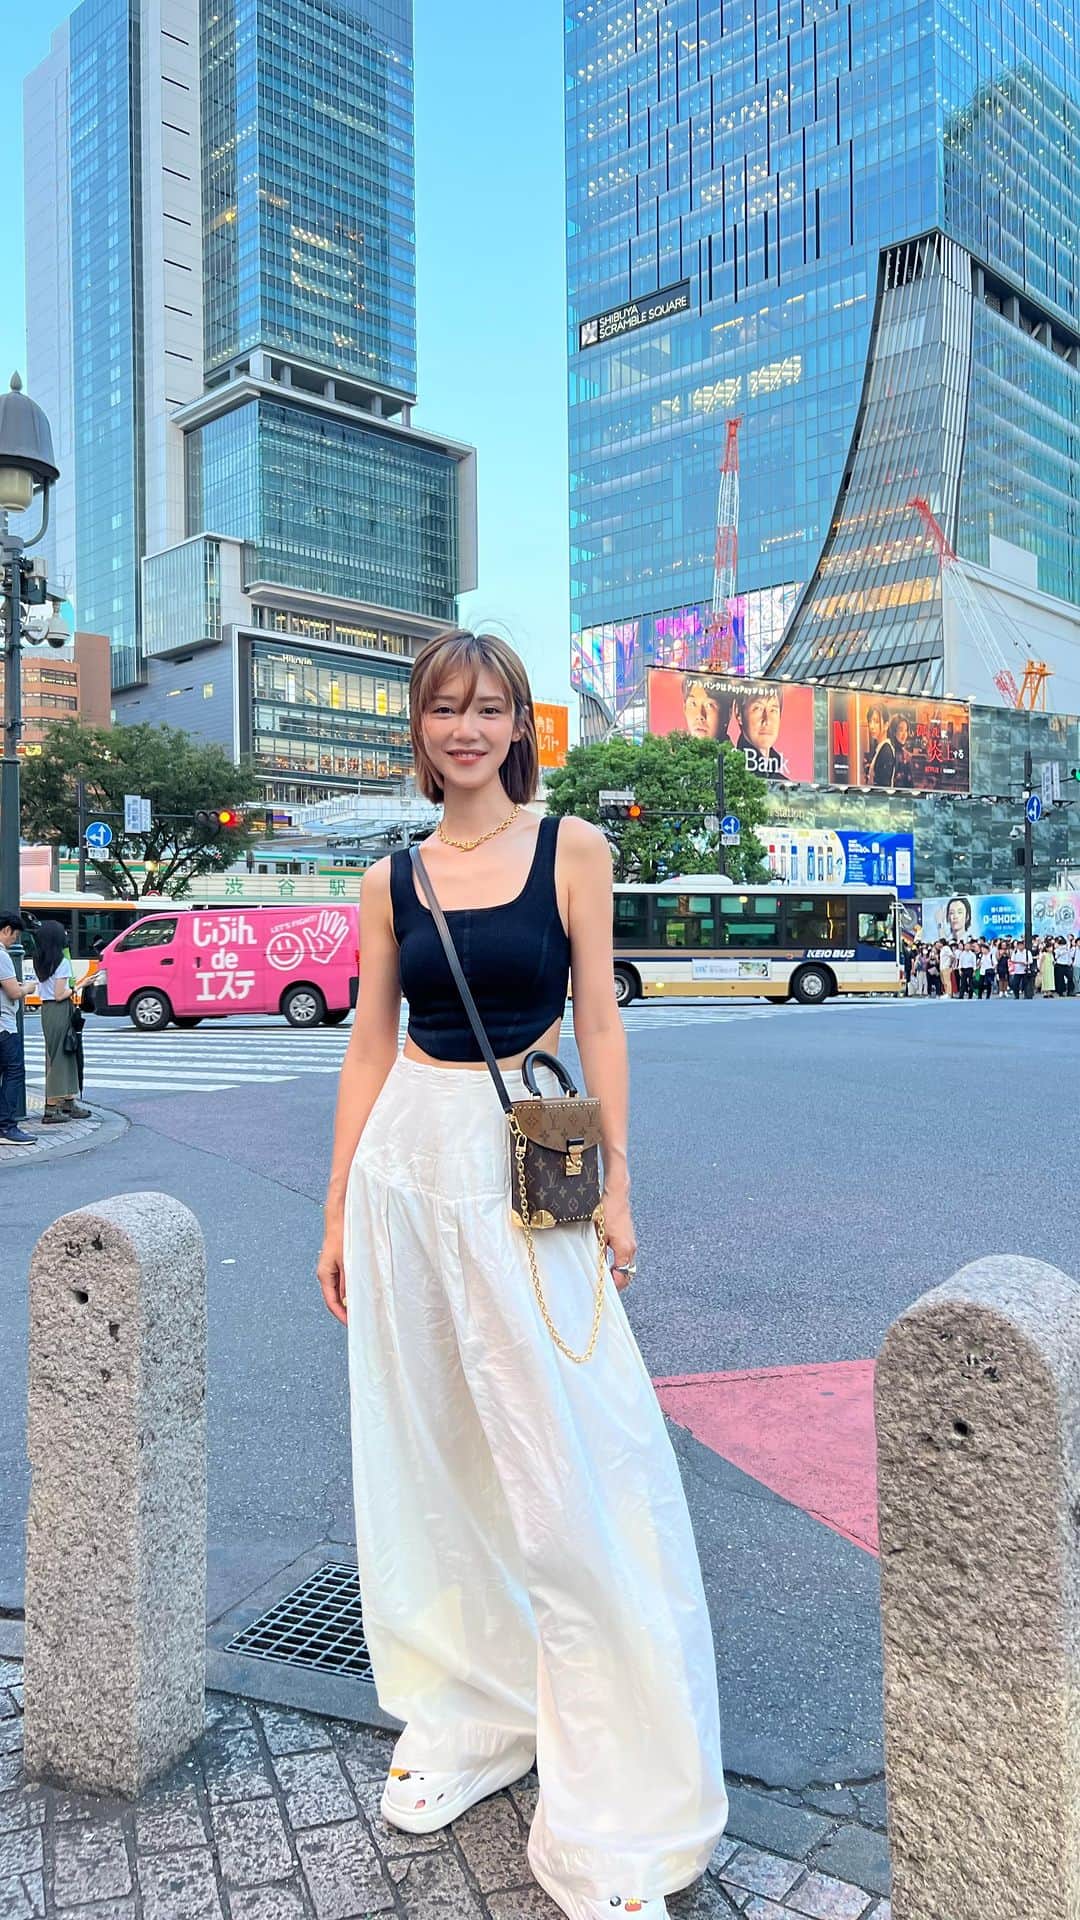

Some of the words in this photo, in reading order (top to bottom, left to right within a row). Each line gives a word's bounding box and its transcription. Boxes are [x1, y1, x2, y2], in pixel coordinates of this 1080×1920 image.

[599, 304, 639, 328] SHIBUYA
[599, 311, 647, 339] SCRAMBLE
[648, 296, 687, 320] SQUARE
[832, 720, 849, 756] N
[731, 746, 791, 775] Bank
[225, 877, 346, 897] 渋谷駅
[193, 915, 257, 947] じぶん
[211, 948, 239, 970] de
[806, 949, 833, 959] KEIO
[833, 949, 856, 959] BUS
[195, 970, 255, 1001] エステ
